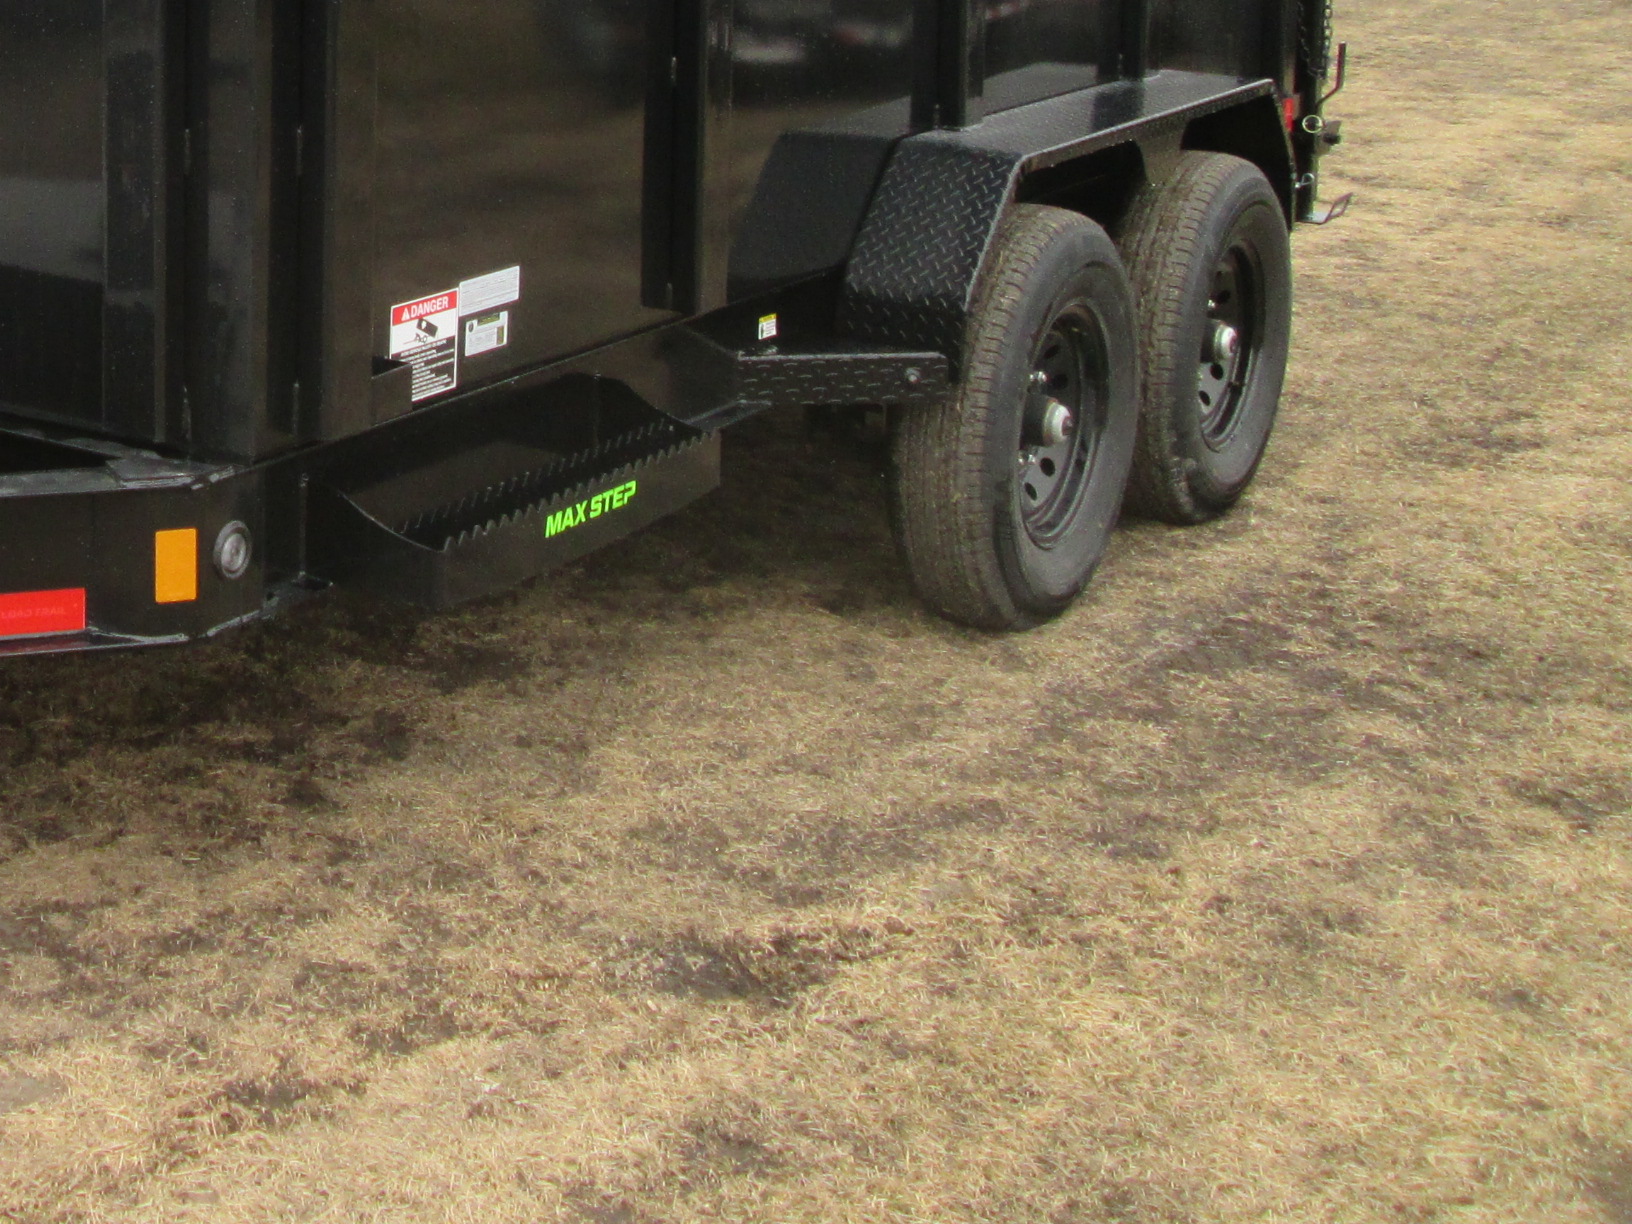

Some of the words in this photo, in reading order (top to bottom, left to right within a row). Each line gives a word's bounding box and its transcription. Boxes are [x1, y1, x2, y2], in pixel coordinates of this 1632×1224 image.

[410, 295, 449, 318] DANGER
[545, 500, 588, 539] MAX
[589, 480, 637, 519] STEP
